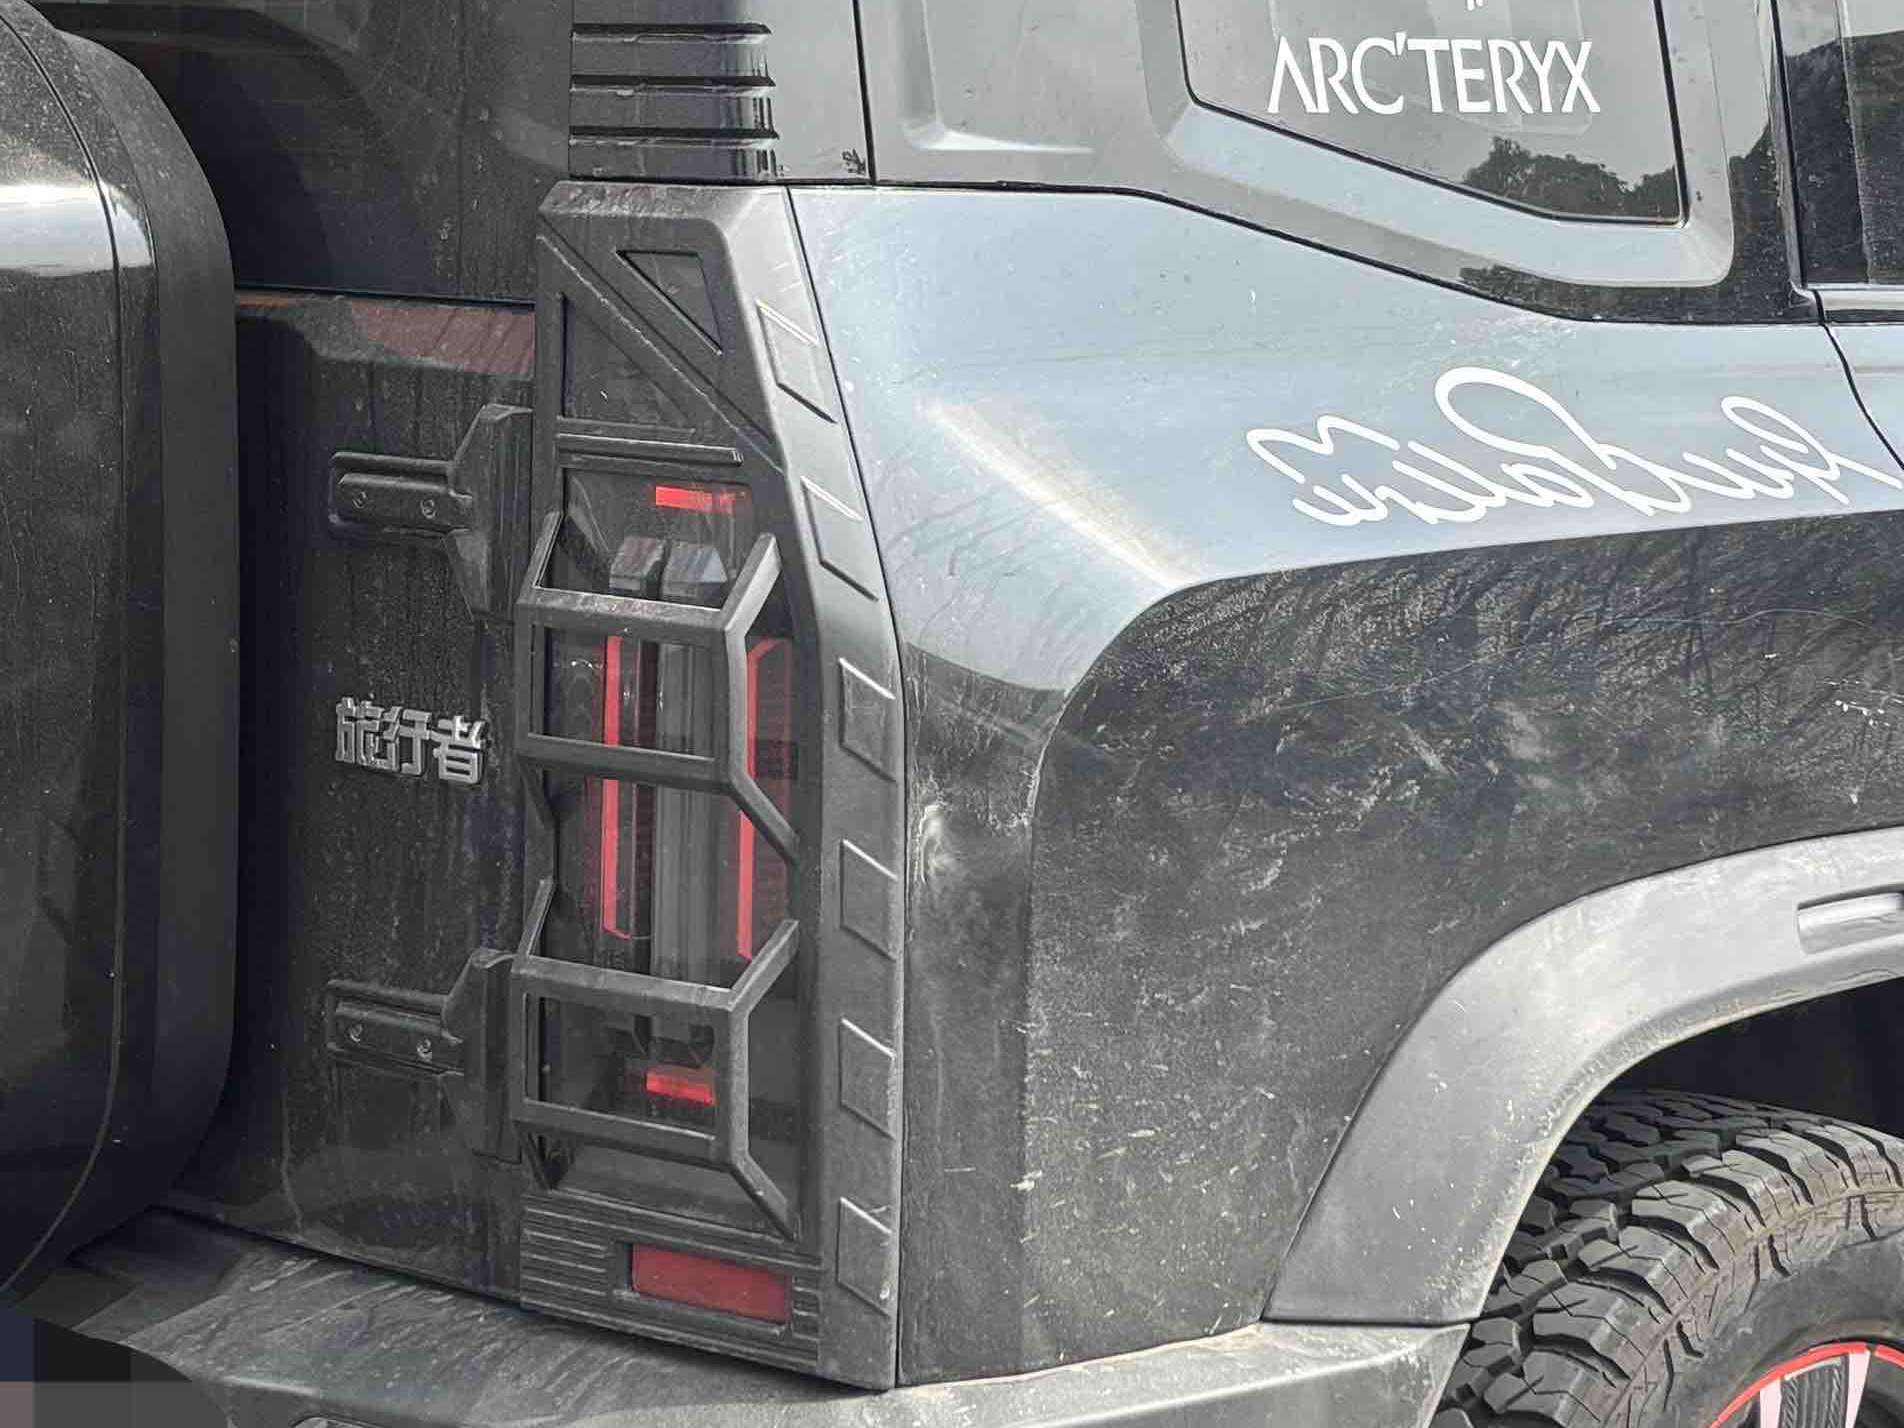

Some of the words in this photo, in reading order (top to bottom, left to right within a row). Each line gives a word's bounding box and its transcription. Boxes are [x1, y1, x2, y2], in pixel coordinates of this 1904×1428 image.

[1267, 29, 1602, 115] ARC'TERYX
[335, 696, 487, 785] 旅行者
